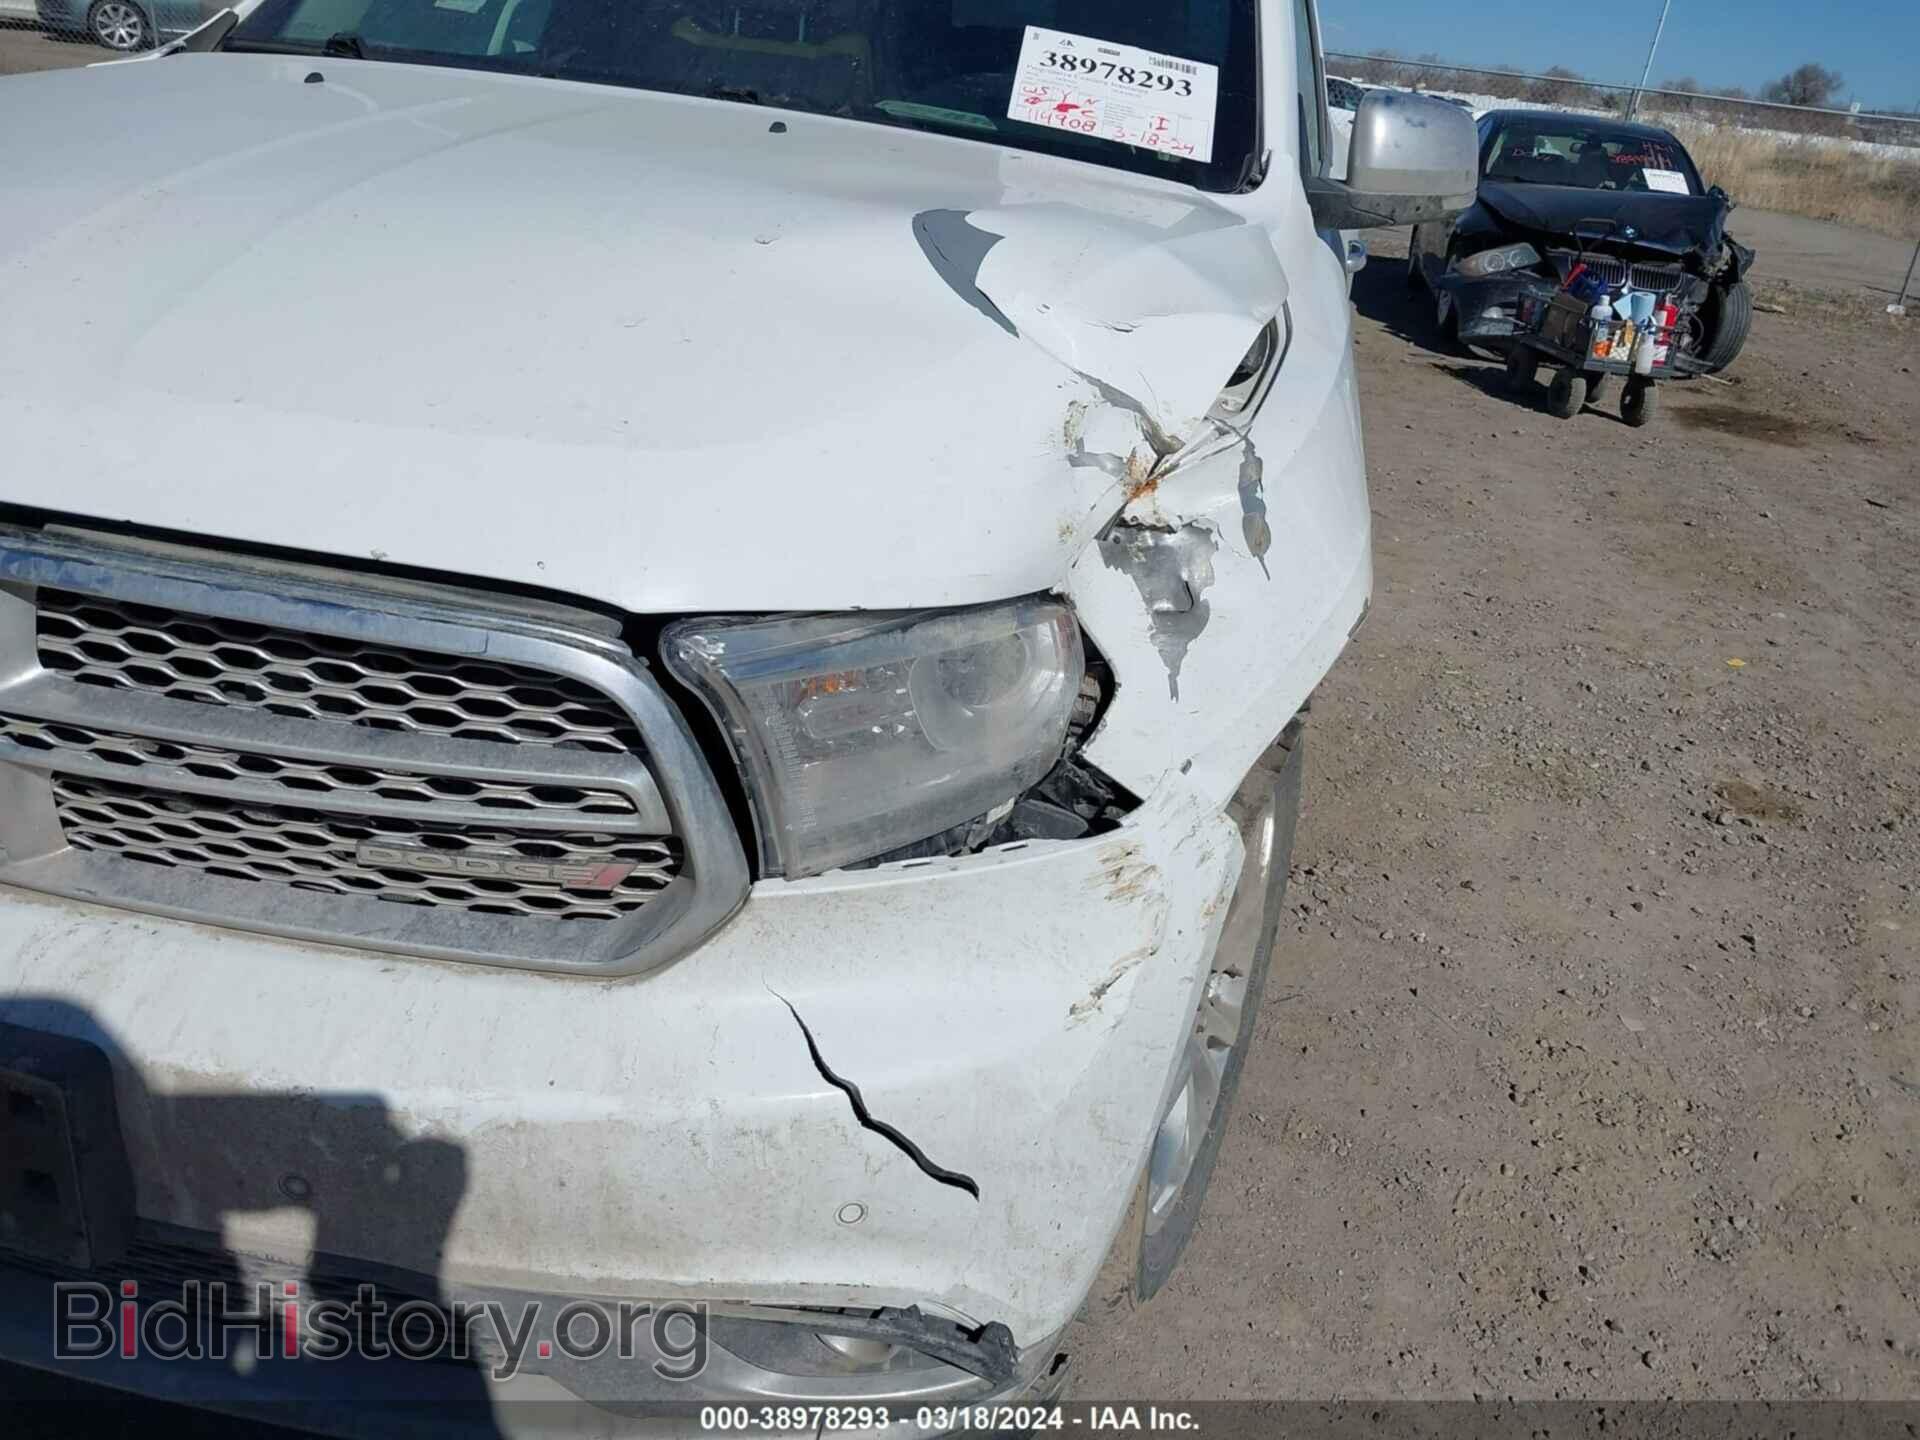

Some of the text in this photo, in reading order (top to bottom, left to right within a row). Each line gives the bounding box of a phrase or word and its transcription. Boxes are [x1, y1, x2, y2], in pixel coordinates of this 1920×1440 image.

[1039, 50, 1193, 97] 38978293
[1111, 126, 1195, 155] 3-18-24
[362, 846, 598, 885] DODGE
